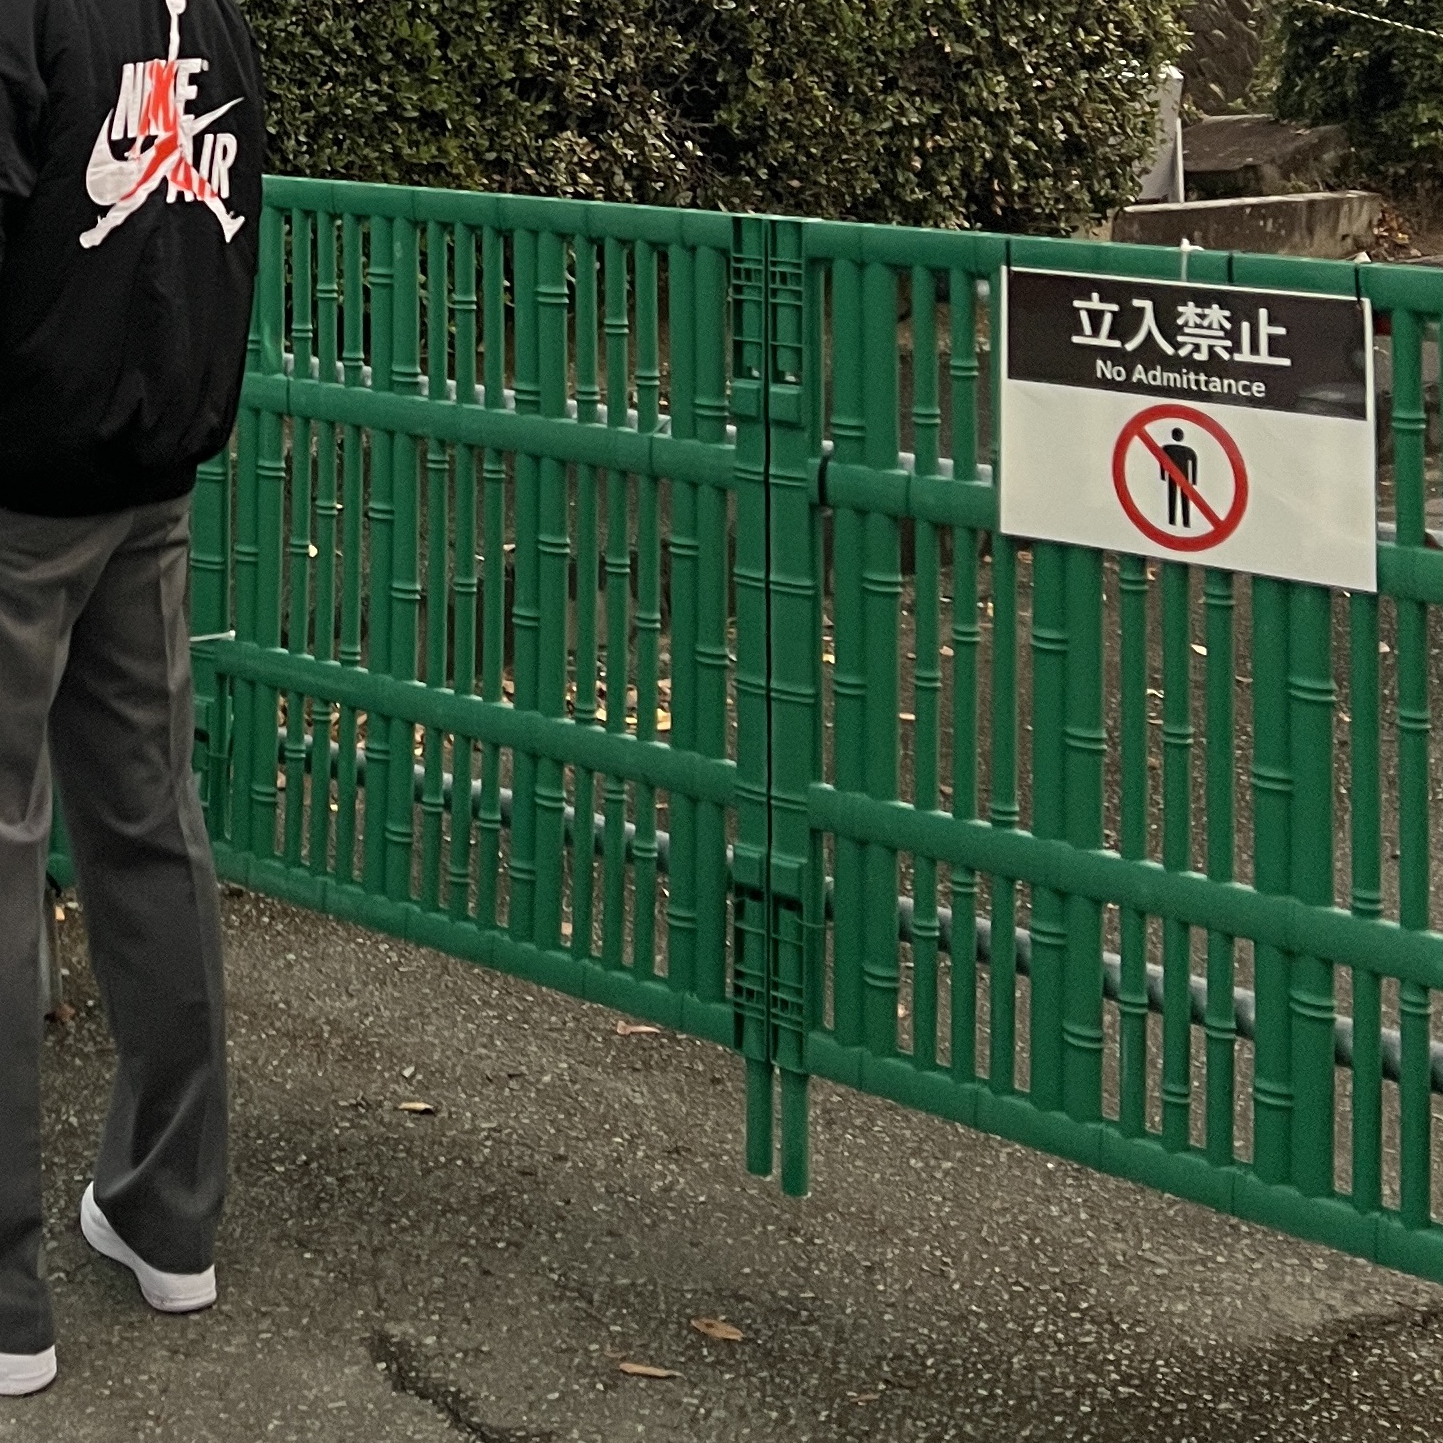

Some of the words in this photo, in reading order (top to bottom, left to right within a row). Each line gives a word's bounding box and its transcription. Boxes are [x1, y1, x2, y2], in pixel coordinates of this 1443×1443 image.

[1070, 292, 1292, 367] 立入禁止
[1095, 359, 1126, 384] No
[1131, 363, 1266, 398] Admittance
